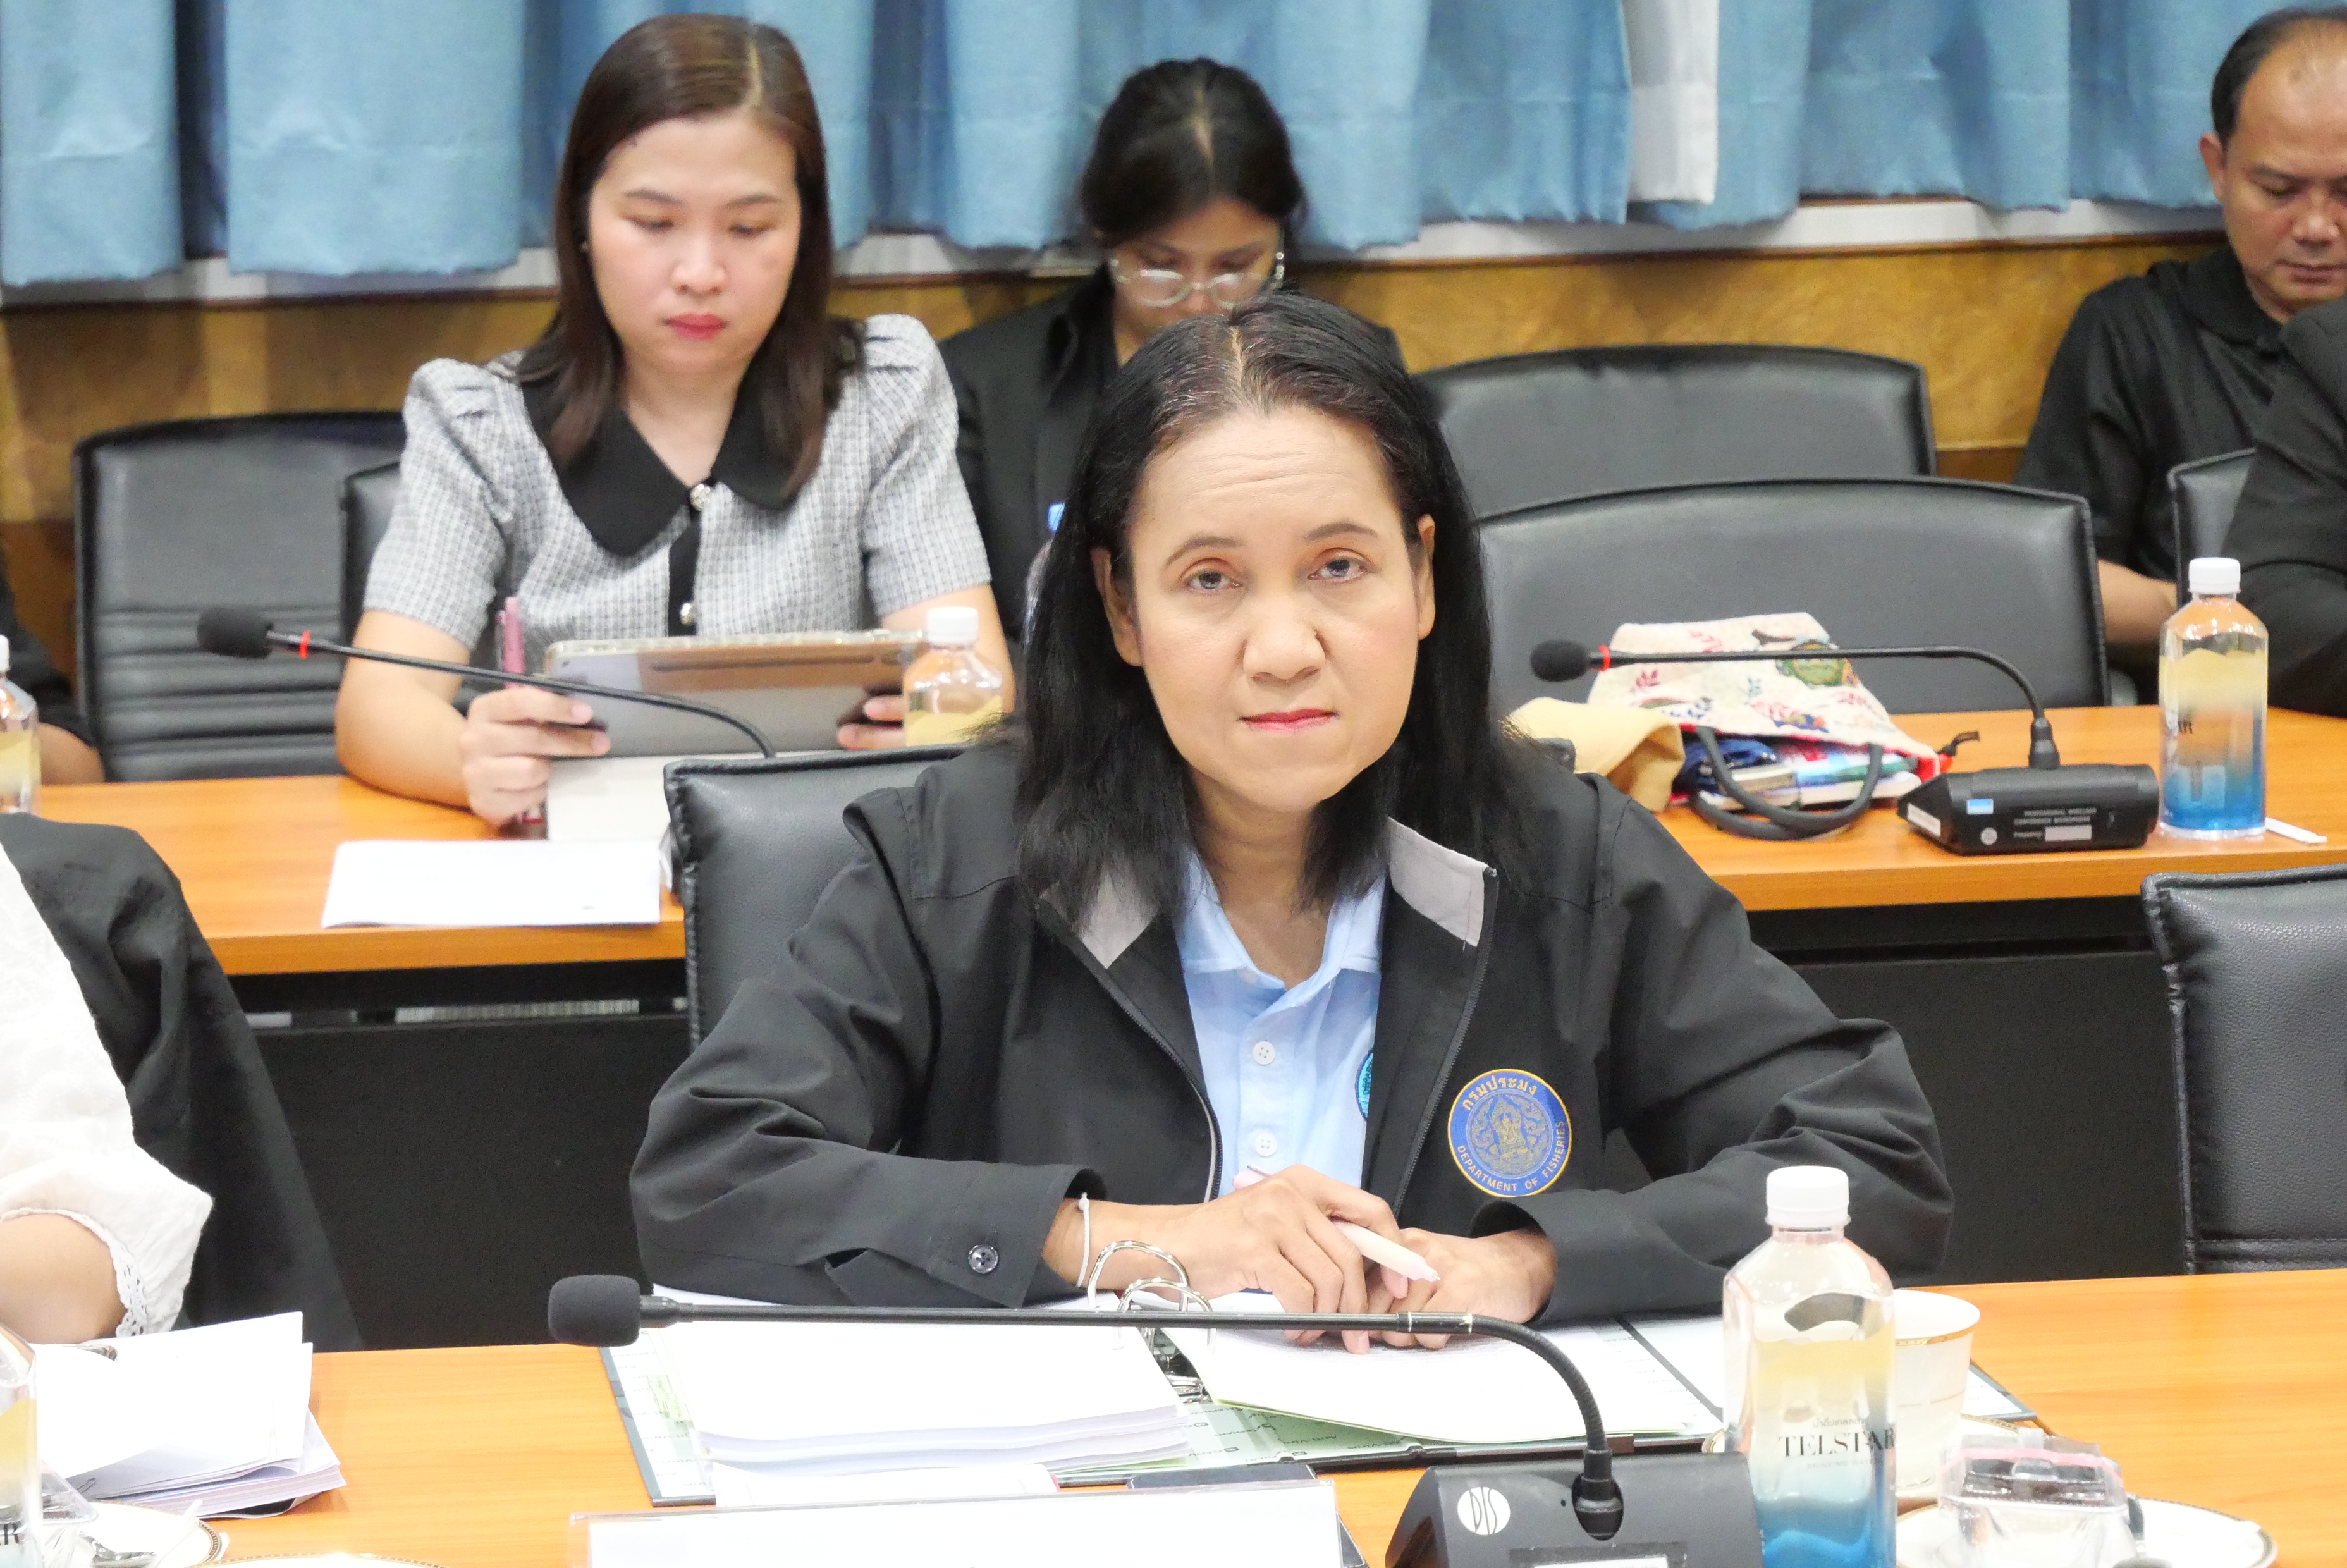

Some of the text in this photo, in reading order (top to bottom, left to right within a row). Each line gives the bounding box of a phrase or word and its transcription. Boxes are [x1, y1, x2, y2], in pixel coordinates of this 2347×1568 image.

[1462, 1075, 1538, 1111] กรมประมง
[1457, 1120, 1566, 1192] DEPARTMENT OF FISHERIES
